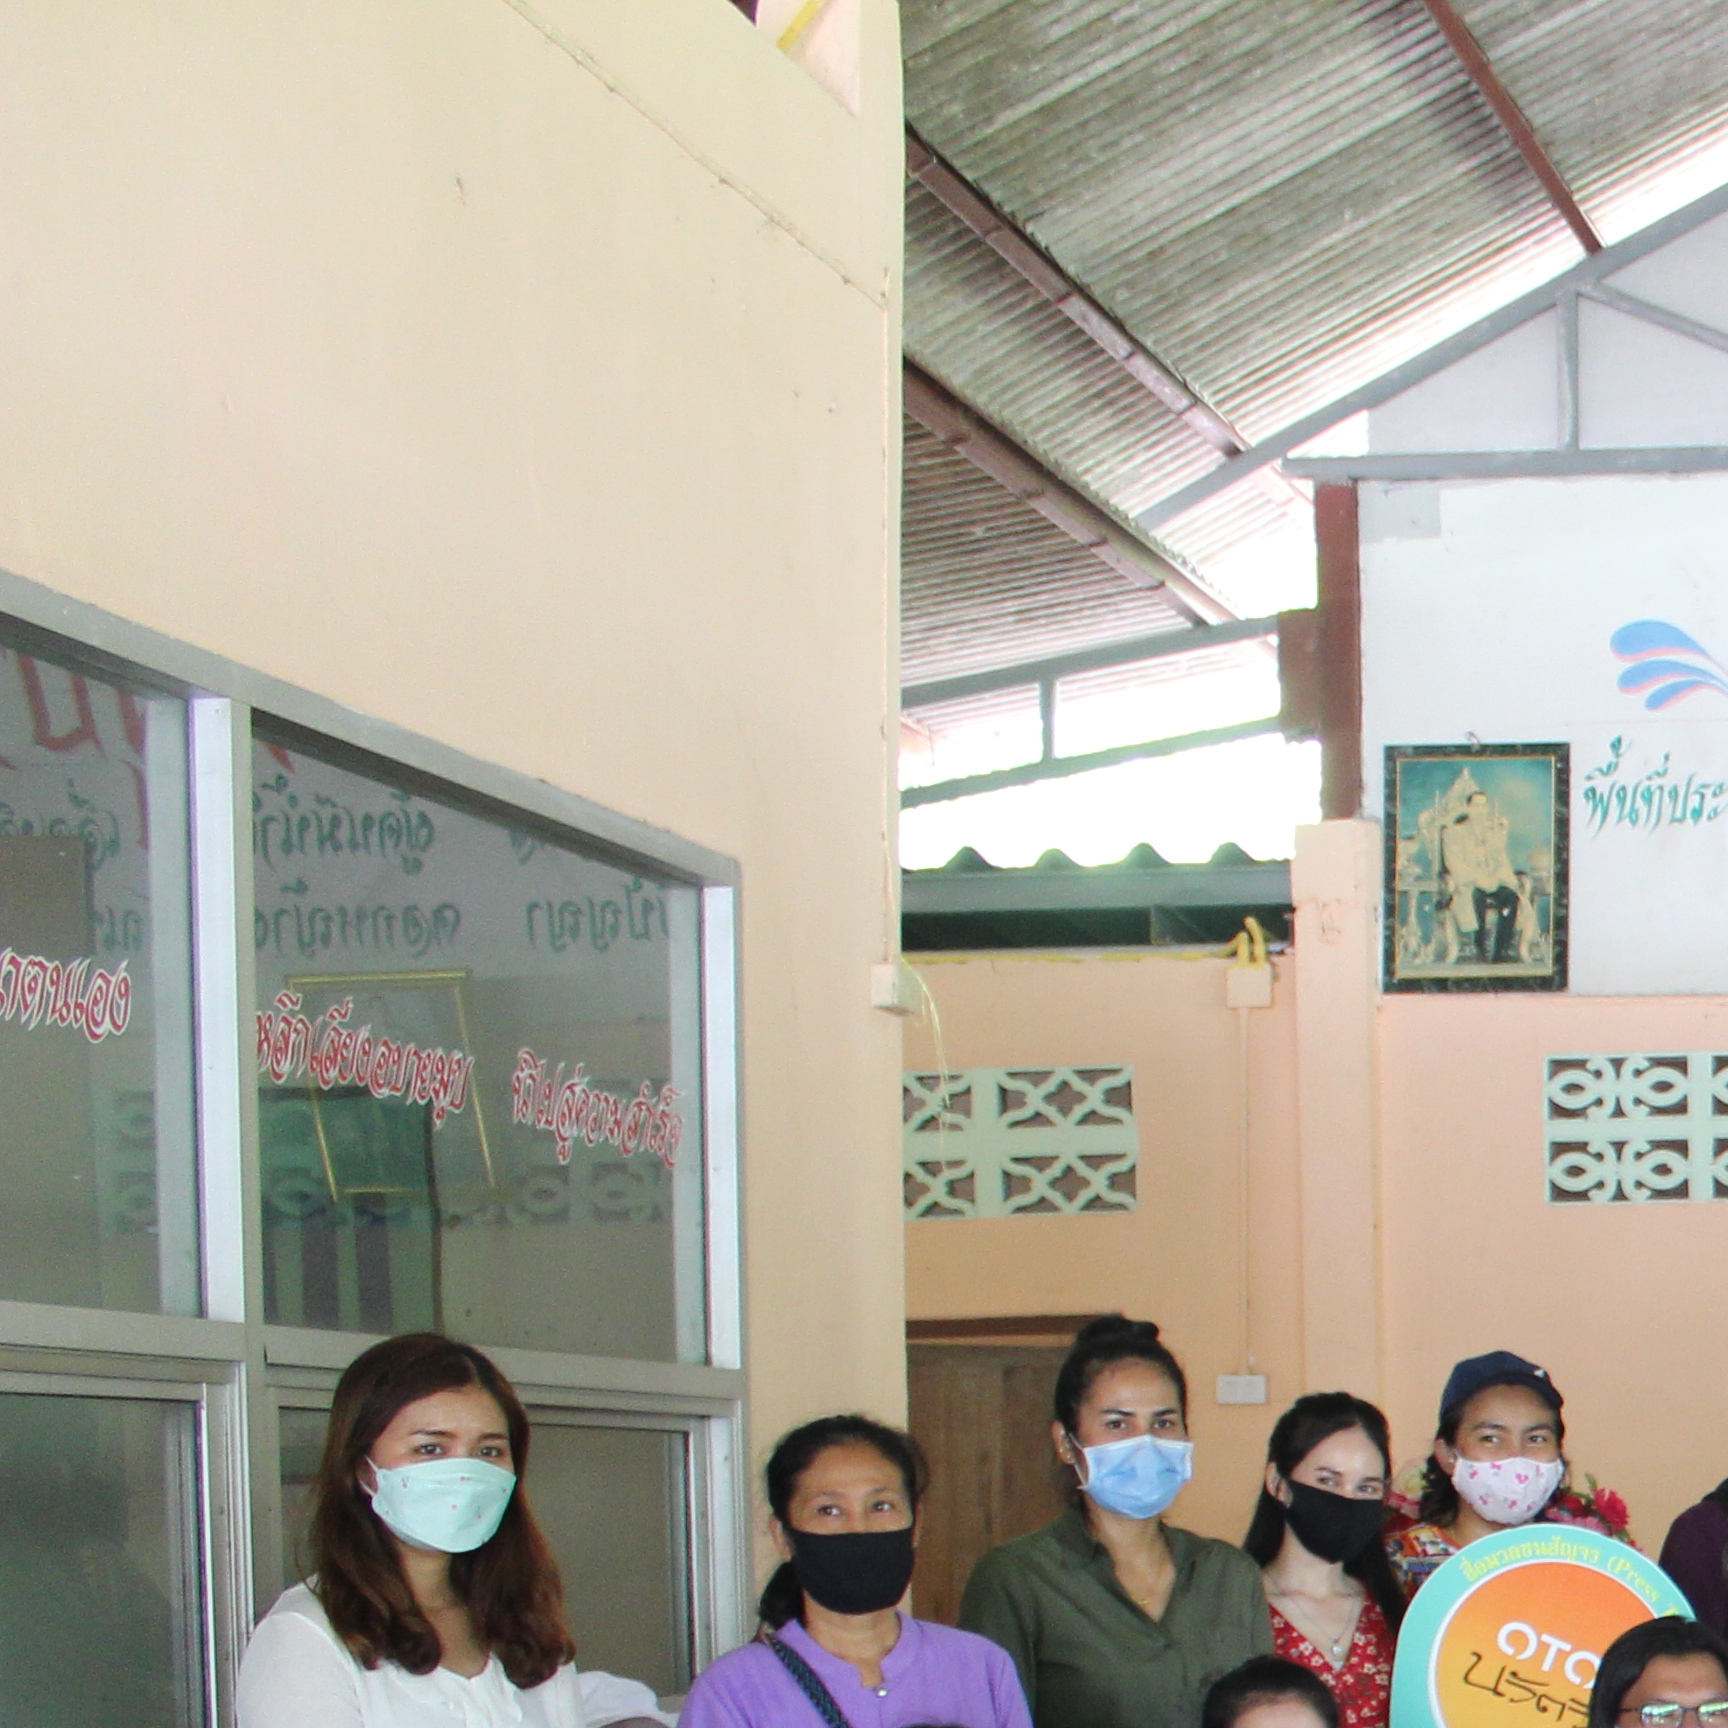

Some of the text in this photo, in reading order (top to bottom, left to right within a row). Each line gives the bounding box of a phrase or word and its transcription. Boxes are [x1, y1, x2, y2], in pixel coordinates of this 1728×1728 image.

[0, 947, 131, 1042] าตนเอง
[1607, 1556, 1660, 1601] (Press
[1497, 1621, 1601, 1690] OTO
